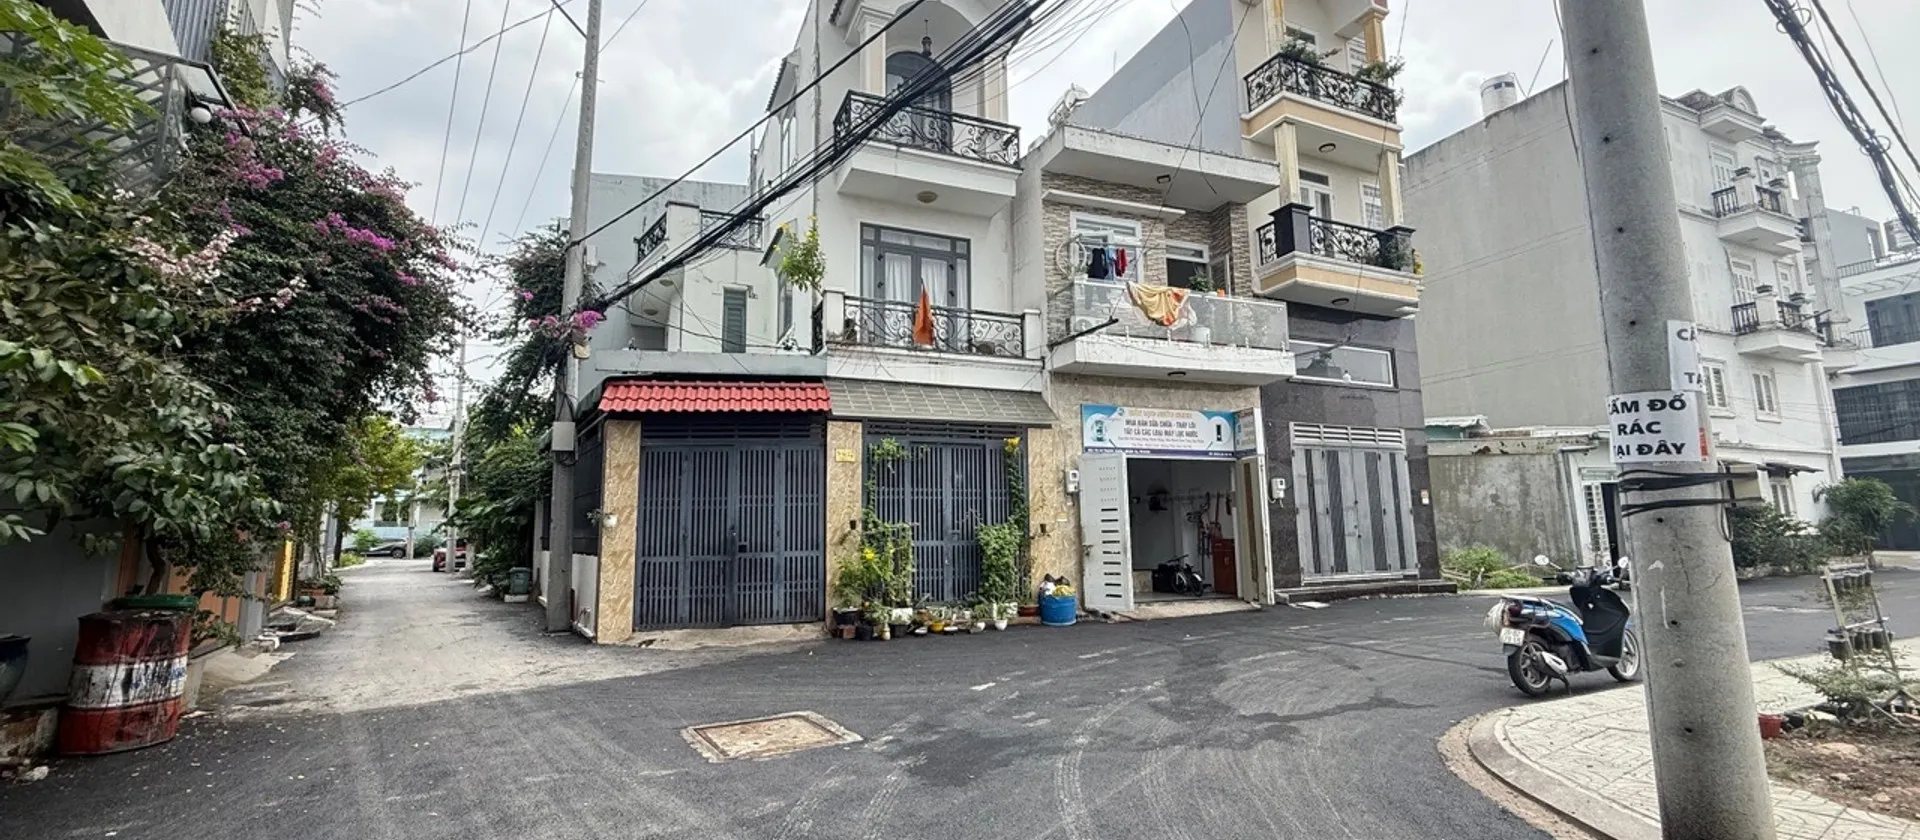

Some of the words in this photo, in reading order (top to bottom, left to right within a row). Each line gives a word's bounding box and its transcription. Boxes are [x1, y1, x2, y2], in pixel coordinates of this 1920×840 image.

[1608, 398, 1640, 415] ẤM
[1647, 393, 1687, 412] ĐỐ
[1617, 418, 1662, 436] RÁC
[1613, 444, 1631, 459] ẠI
[1636, 439, 1686, 456] ĐÂY
